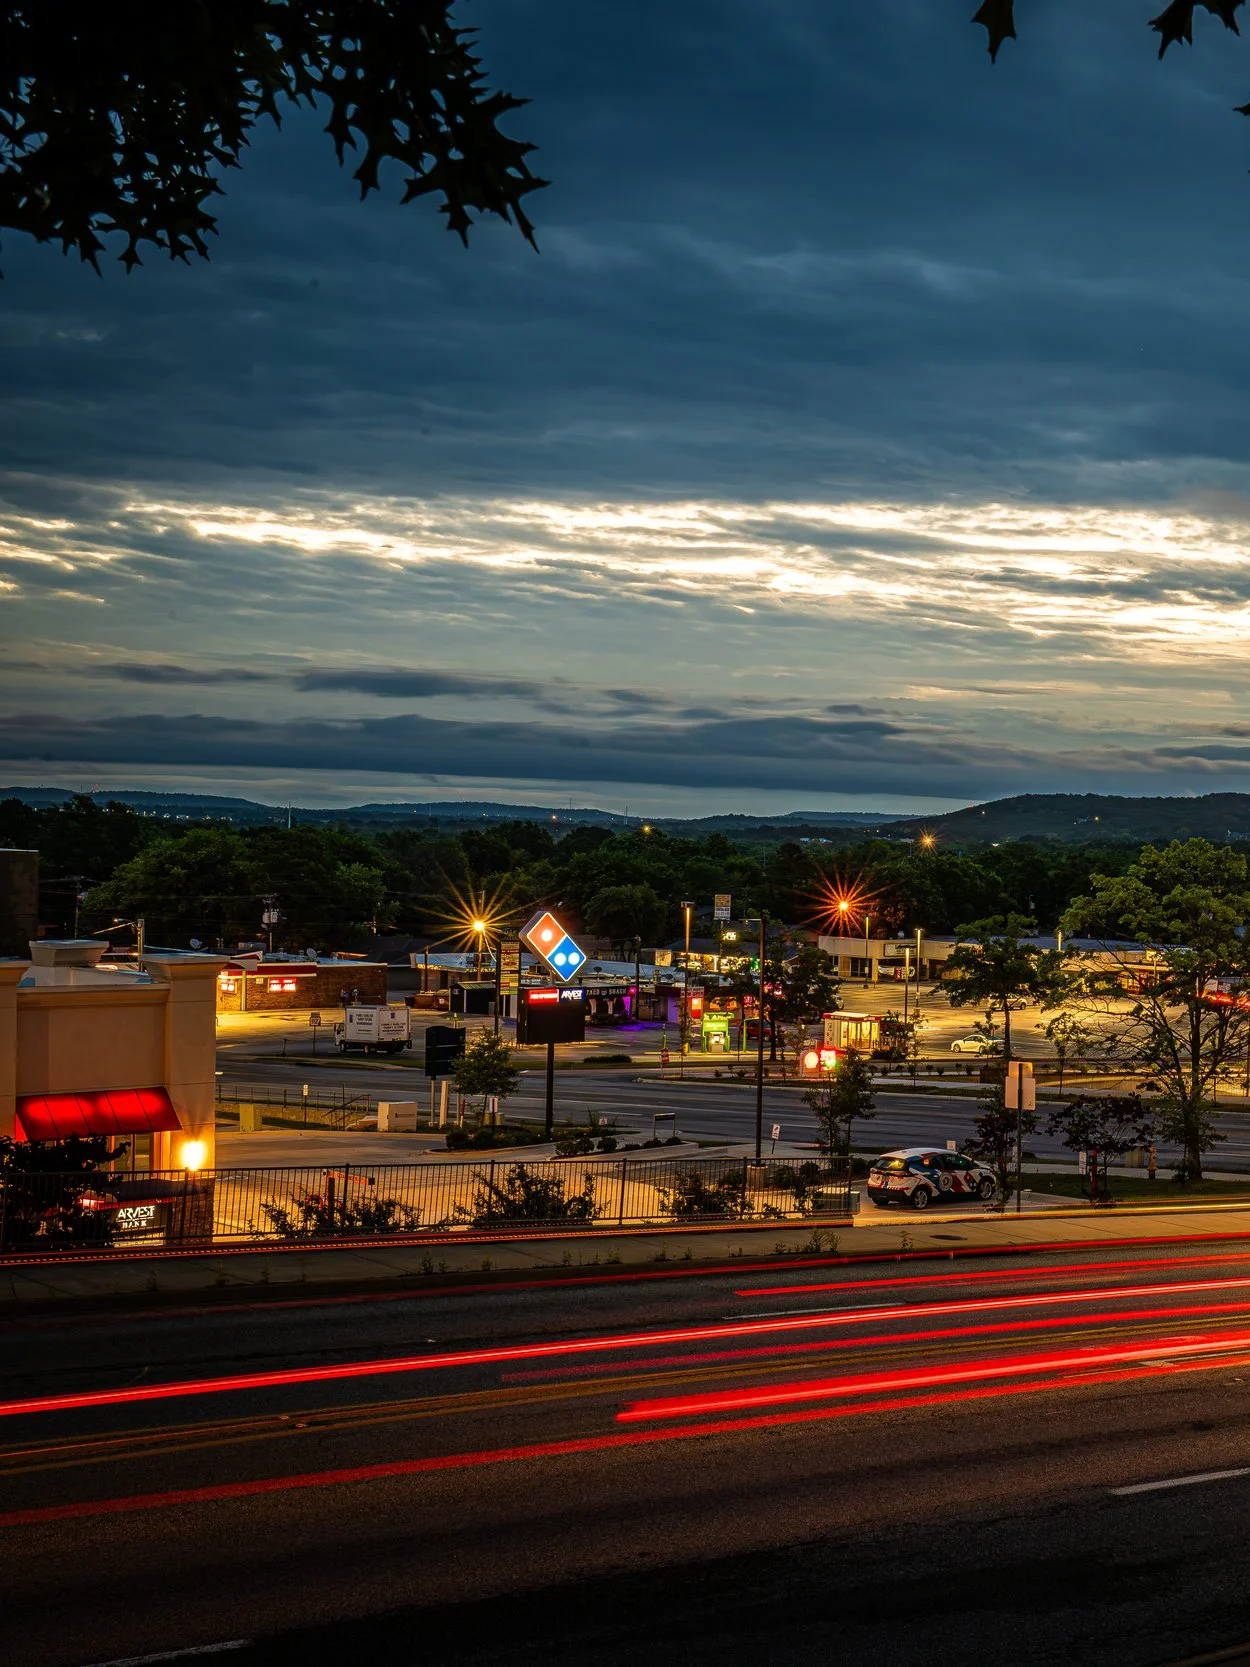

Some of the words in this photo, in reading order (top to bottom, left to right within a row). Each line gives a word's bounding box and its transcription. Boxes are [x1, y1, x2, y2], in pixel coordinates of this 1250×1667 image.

[561, 990, 583, 1000] ARVEST
[118, 1205, 156, 1219] ARVEST
[122, 1220, 148, 1229] BANK
